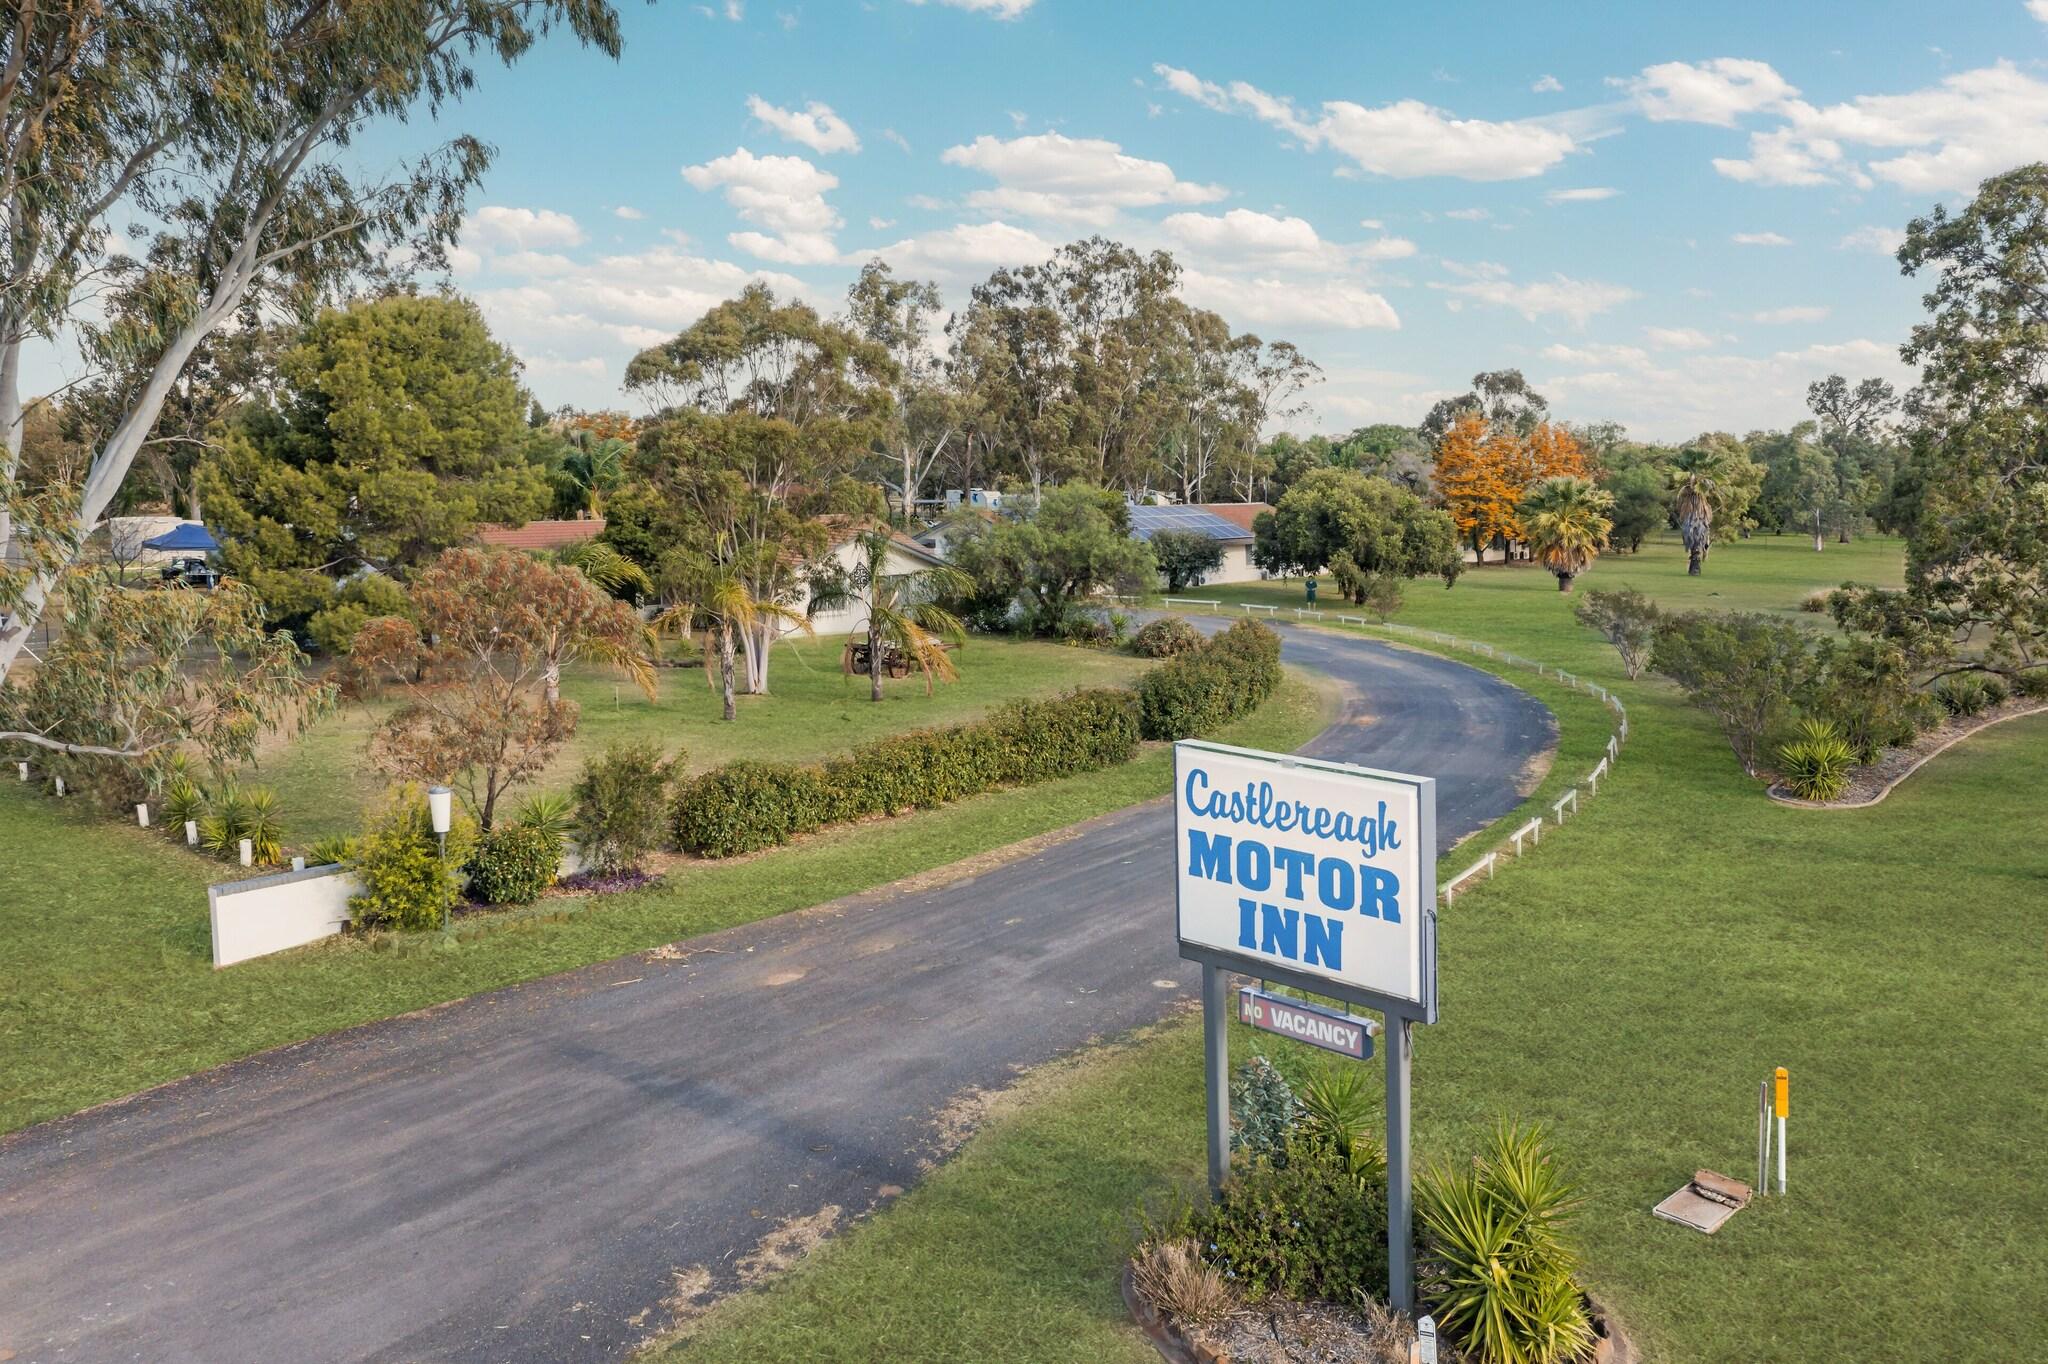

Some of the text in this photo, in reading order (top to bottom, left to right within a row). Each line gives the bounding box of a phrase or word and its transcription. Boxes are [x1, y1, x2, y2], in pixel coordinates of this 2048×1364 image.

[1185, 768, 1401, 859] Castlereagh
[1188, 829, 1401, 924] MOTOR
[1238, 897, 1344, 971] INN
[1244, 1003, 1358, 1049] NO VACANCY
